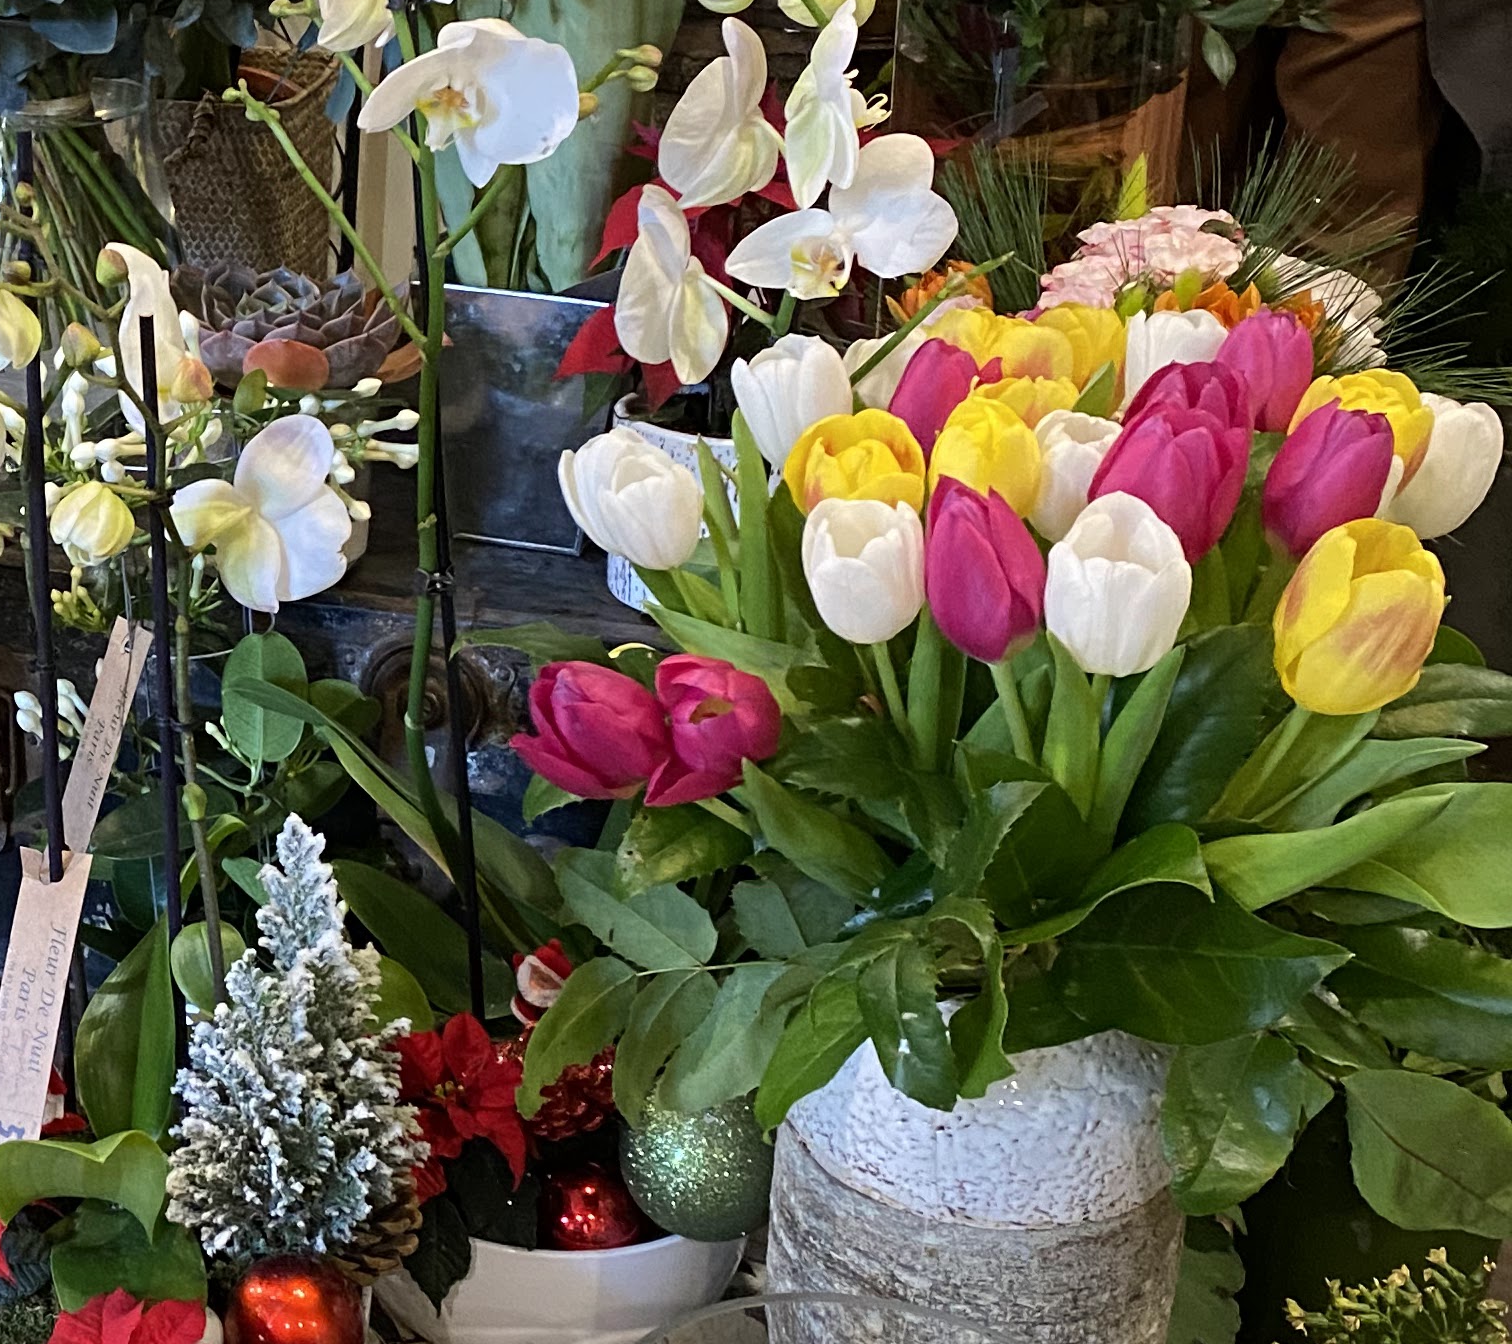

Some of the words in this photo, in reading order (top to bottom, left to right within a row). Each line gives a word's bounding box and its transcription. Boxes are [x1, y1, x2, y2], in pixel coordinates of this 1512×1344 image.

[45, 920, 68, 983] Fleur
[14, 967, 37, 1022] Paris
[39, 987, 56, 1018] De
[27, 1022, 50, 1074] Nuit
